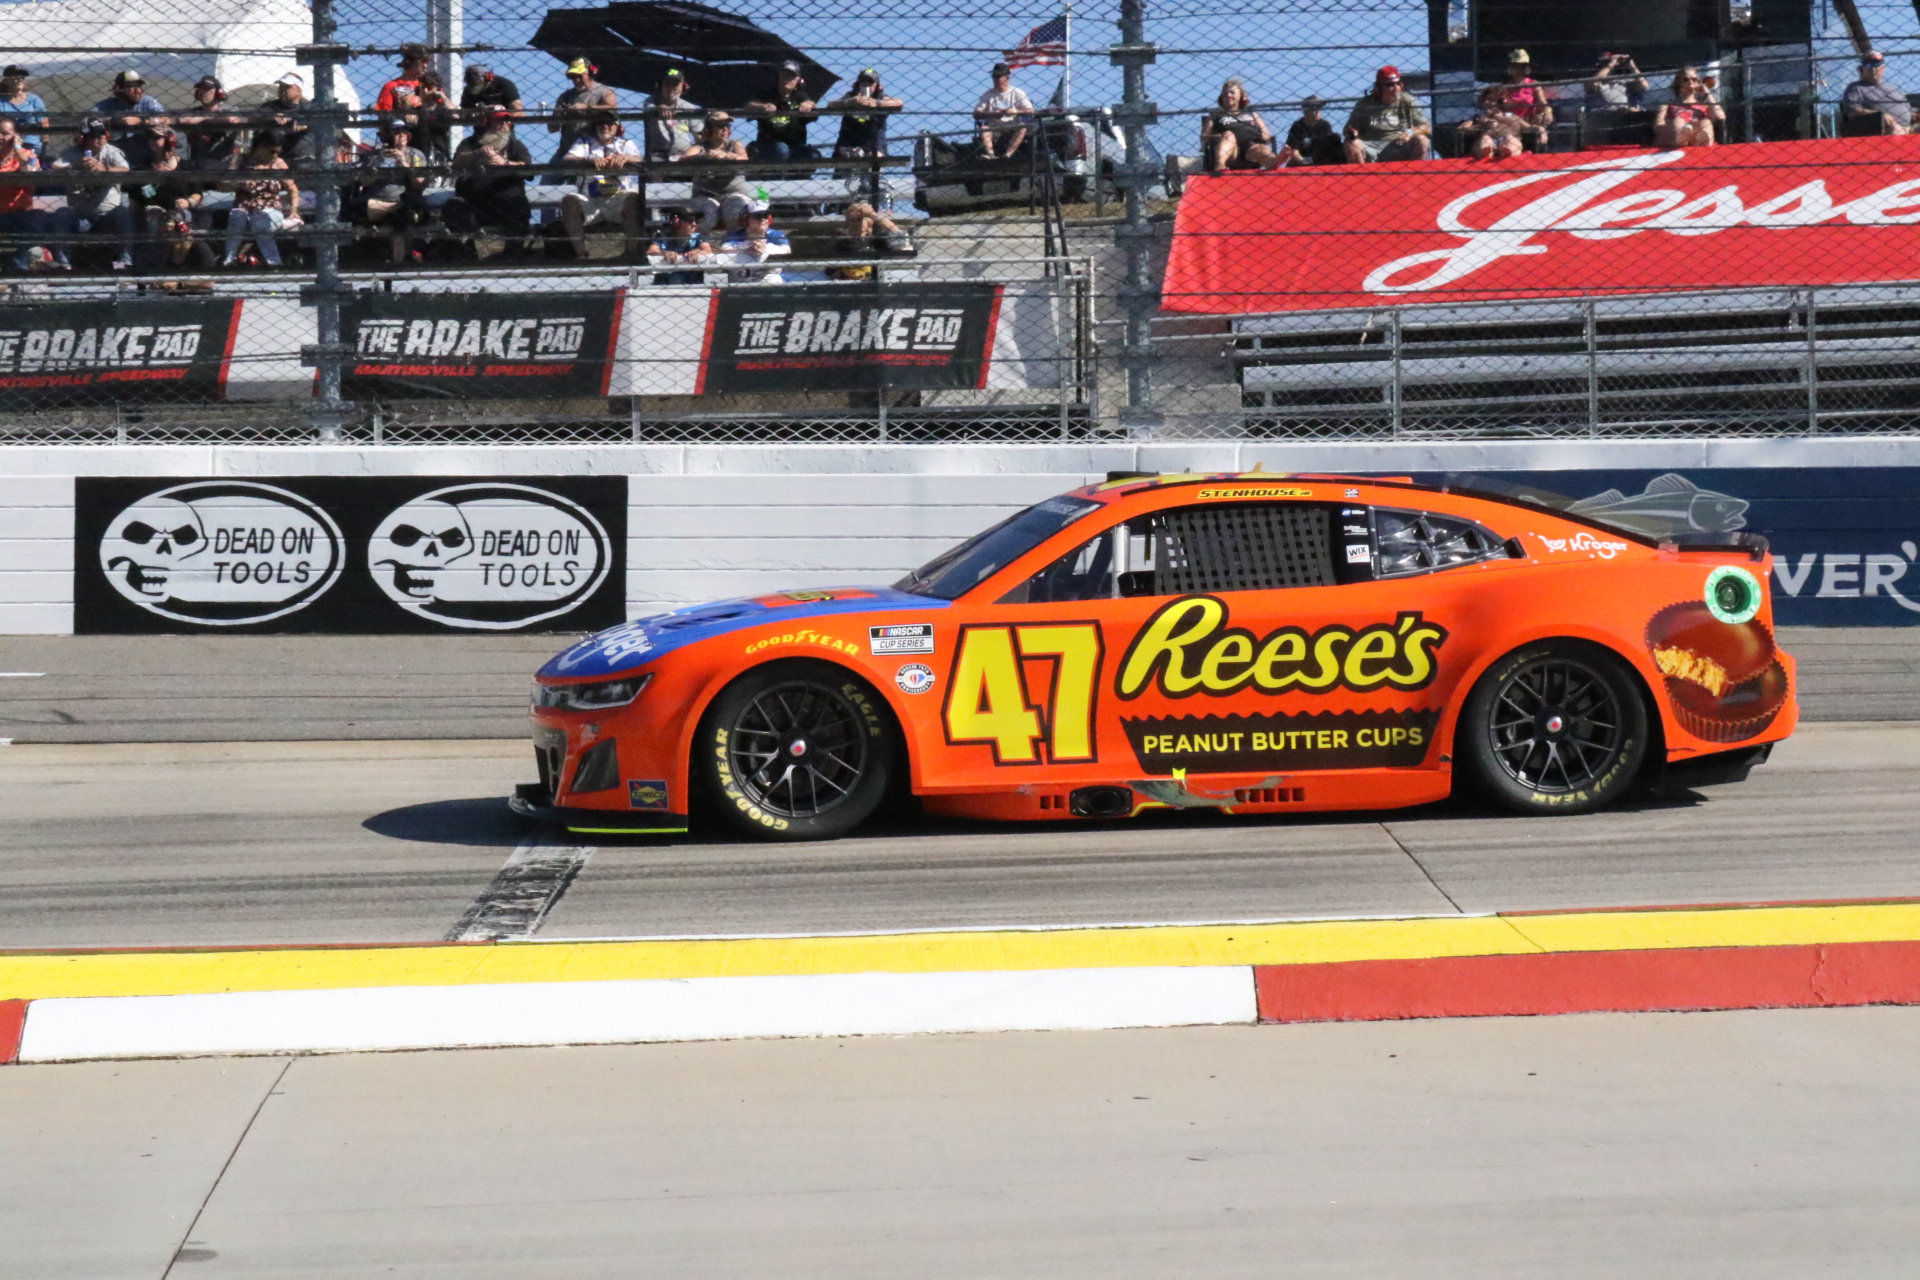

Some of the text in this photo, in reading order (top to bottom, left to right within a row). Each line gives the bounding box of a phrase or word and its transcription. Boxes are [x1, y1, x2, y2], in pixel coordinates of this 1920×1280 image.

[356, 327, 403, 353] THE
[536, 325, 585, 353] PAD
[738, 308, 963, 353] THE BRAKE PAD
[150, 332, 201, 358] PAD
[354, 363, 575, 376] MARTINSVILLE SPEEDWAY
[1198, 488, 1301, 499] STENHOUSE
[213, 527, 315, 554] DEAD ON
[481, 529, 581, 557] DEAD ON
[1348, 546, 1367, 557] WIX
[1568, 532, 1628, 559] Kroger
[213, 561, 312, 584] TOOLS
[479, 561, 581, 587] TOOLS
[880, 639, 925, 649] CUP SERIES
[889, 626, 924, 637] NASCAR
[1119, 597, 1443, 695] Reese's
[943, 621, 1104, 764] 47
[1142, 727, 1424, 755] PEANUT BUTTER CUPS
[633, 790, 666, 800] SUNOCO
